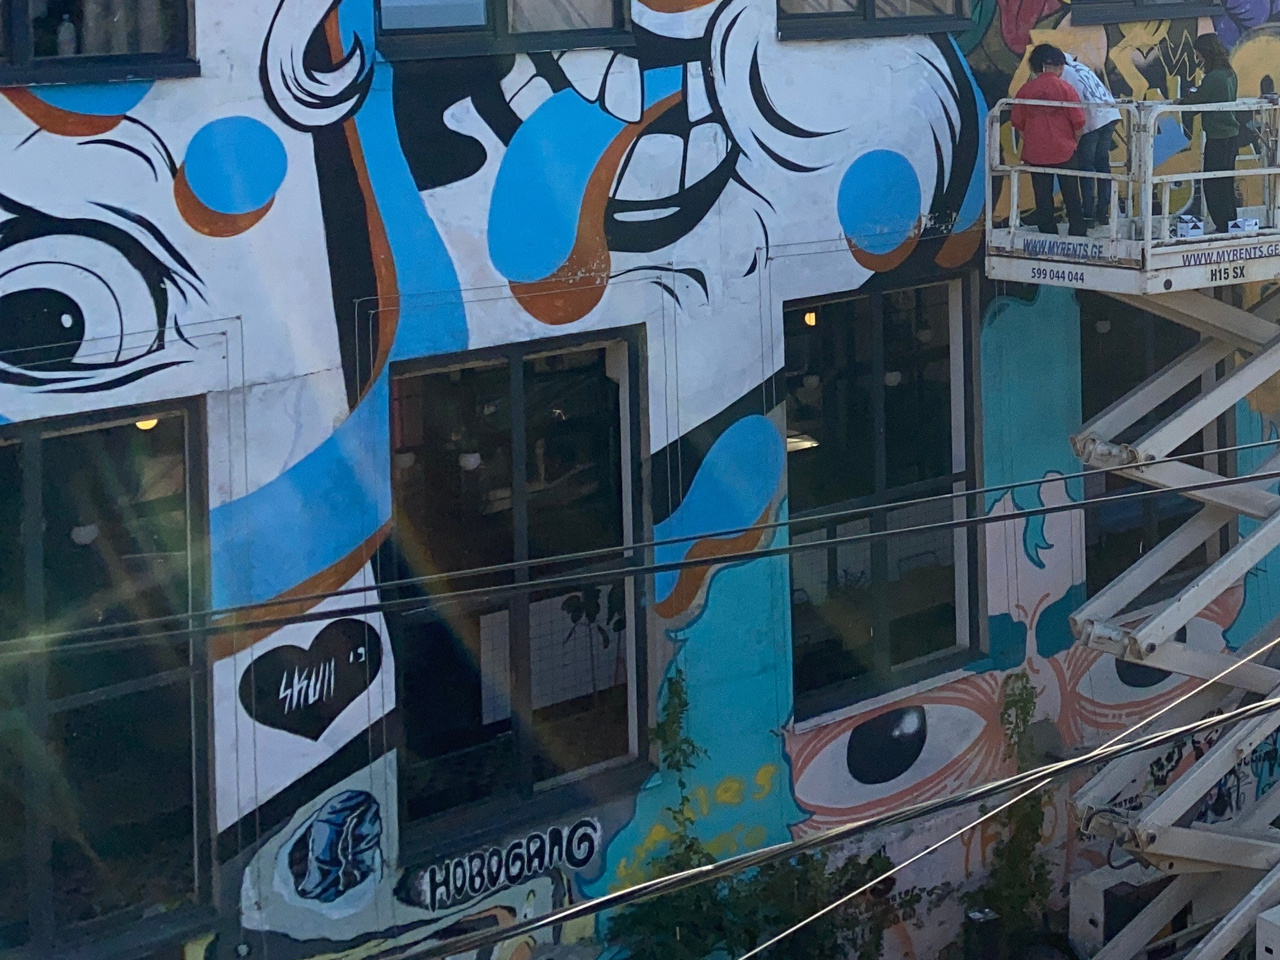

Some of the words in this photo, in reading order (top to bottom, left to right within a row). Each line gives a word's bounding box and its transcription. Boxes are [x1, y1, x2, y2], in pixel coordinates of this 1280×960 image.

[1022, 238, 1104, 260] WWW.MYRENTS.GE
[1182, 243, 1280, 267] WWW.MYRENTS.GE
[1031, 267, 1047, 279] 599
[1050, 269, 1067, 282] 044
[1068, 271, 1085, 284] 044
[1210, 267, 1230, 282] H15
[1232, 264, 1246, 279] SX
[428, 817, 602, 913] HOBOGANG
